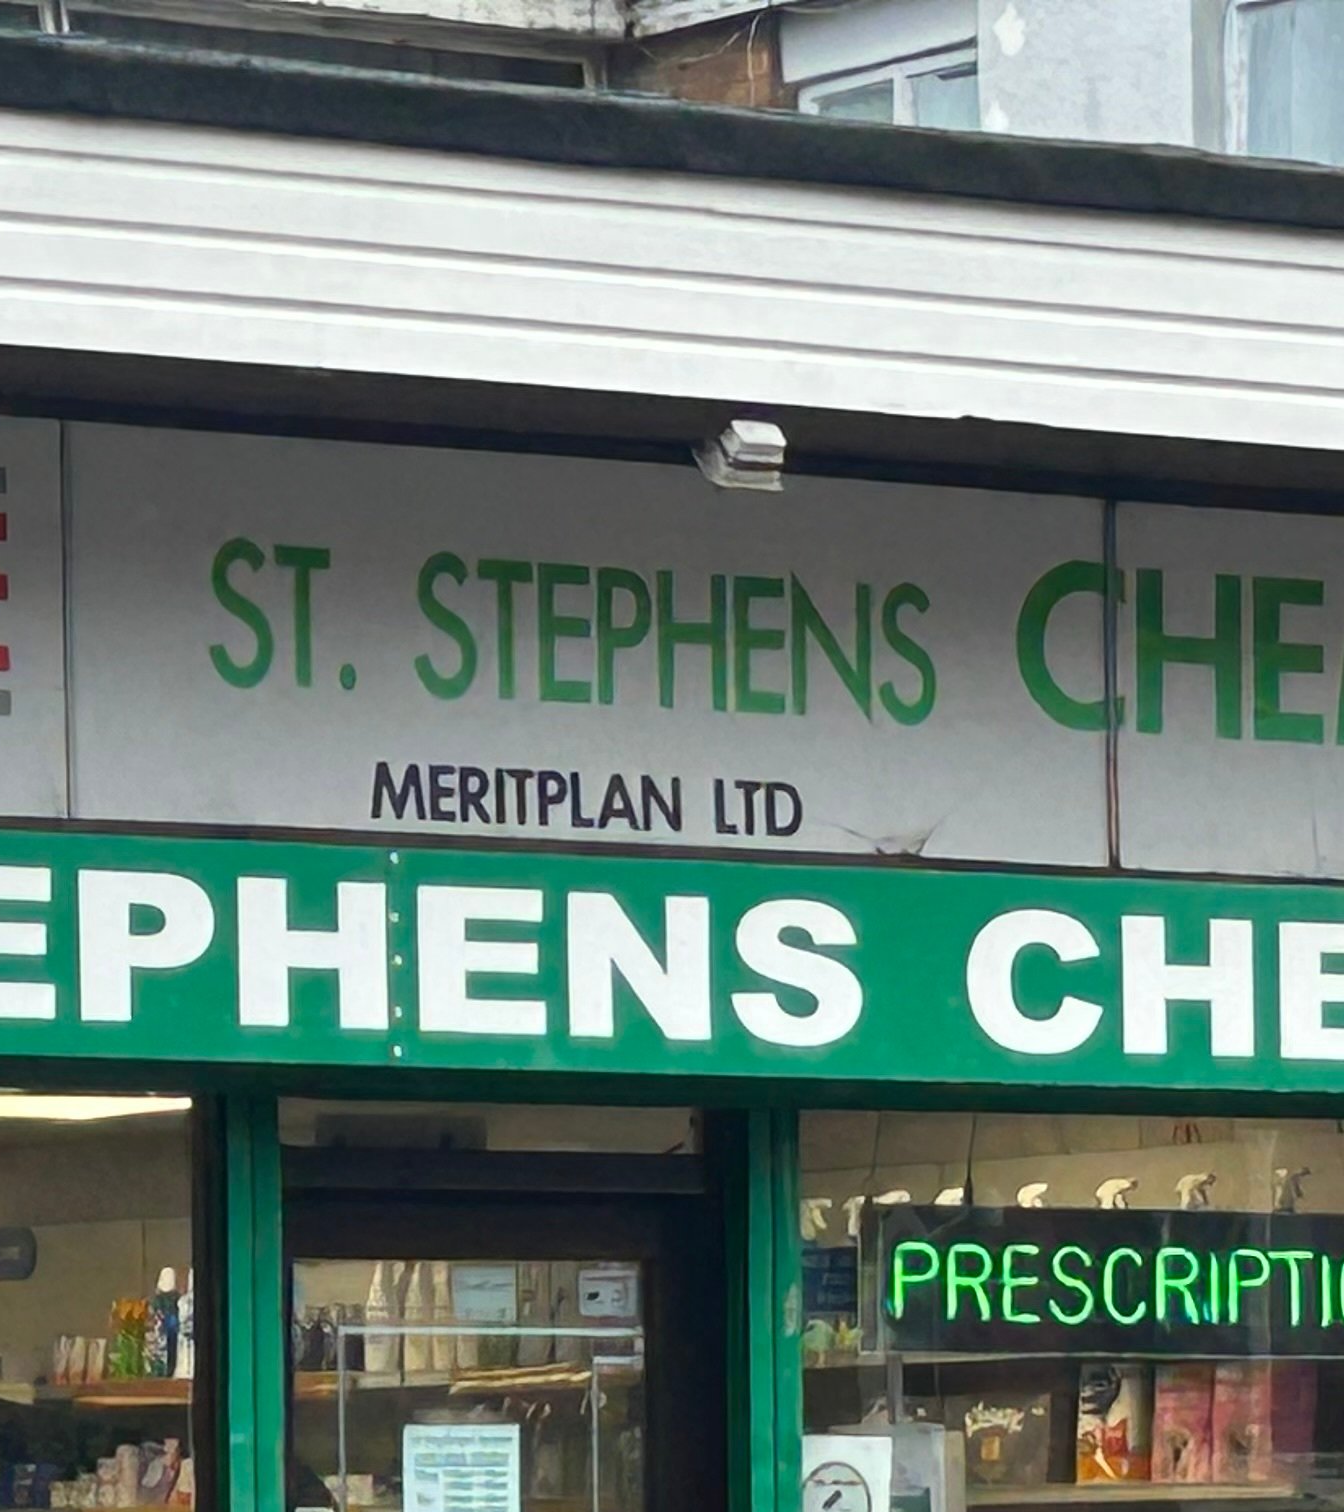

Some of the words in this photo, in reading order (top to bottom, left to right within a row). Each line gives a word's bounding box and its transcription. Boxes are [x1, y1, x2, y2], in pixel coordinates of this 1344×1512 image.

[209, 537, 358, 691] ST.
[414, 551, 938, 727] STEPHENS
[371, 761, 682, 833] MERITPLAN
[713, 778, 804, 837] LTD
